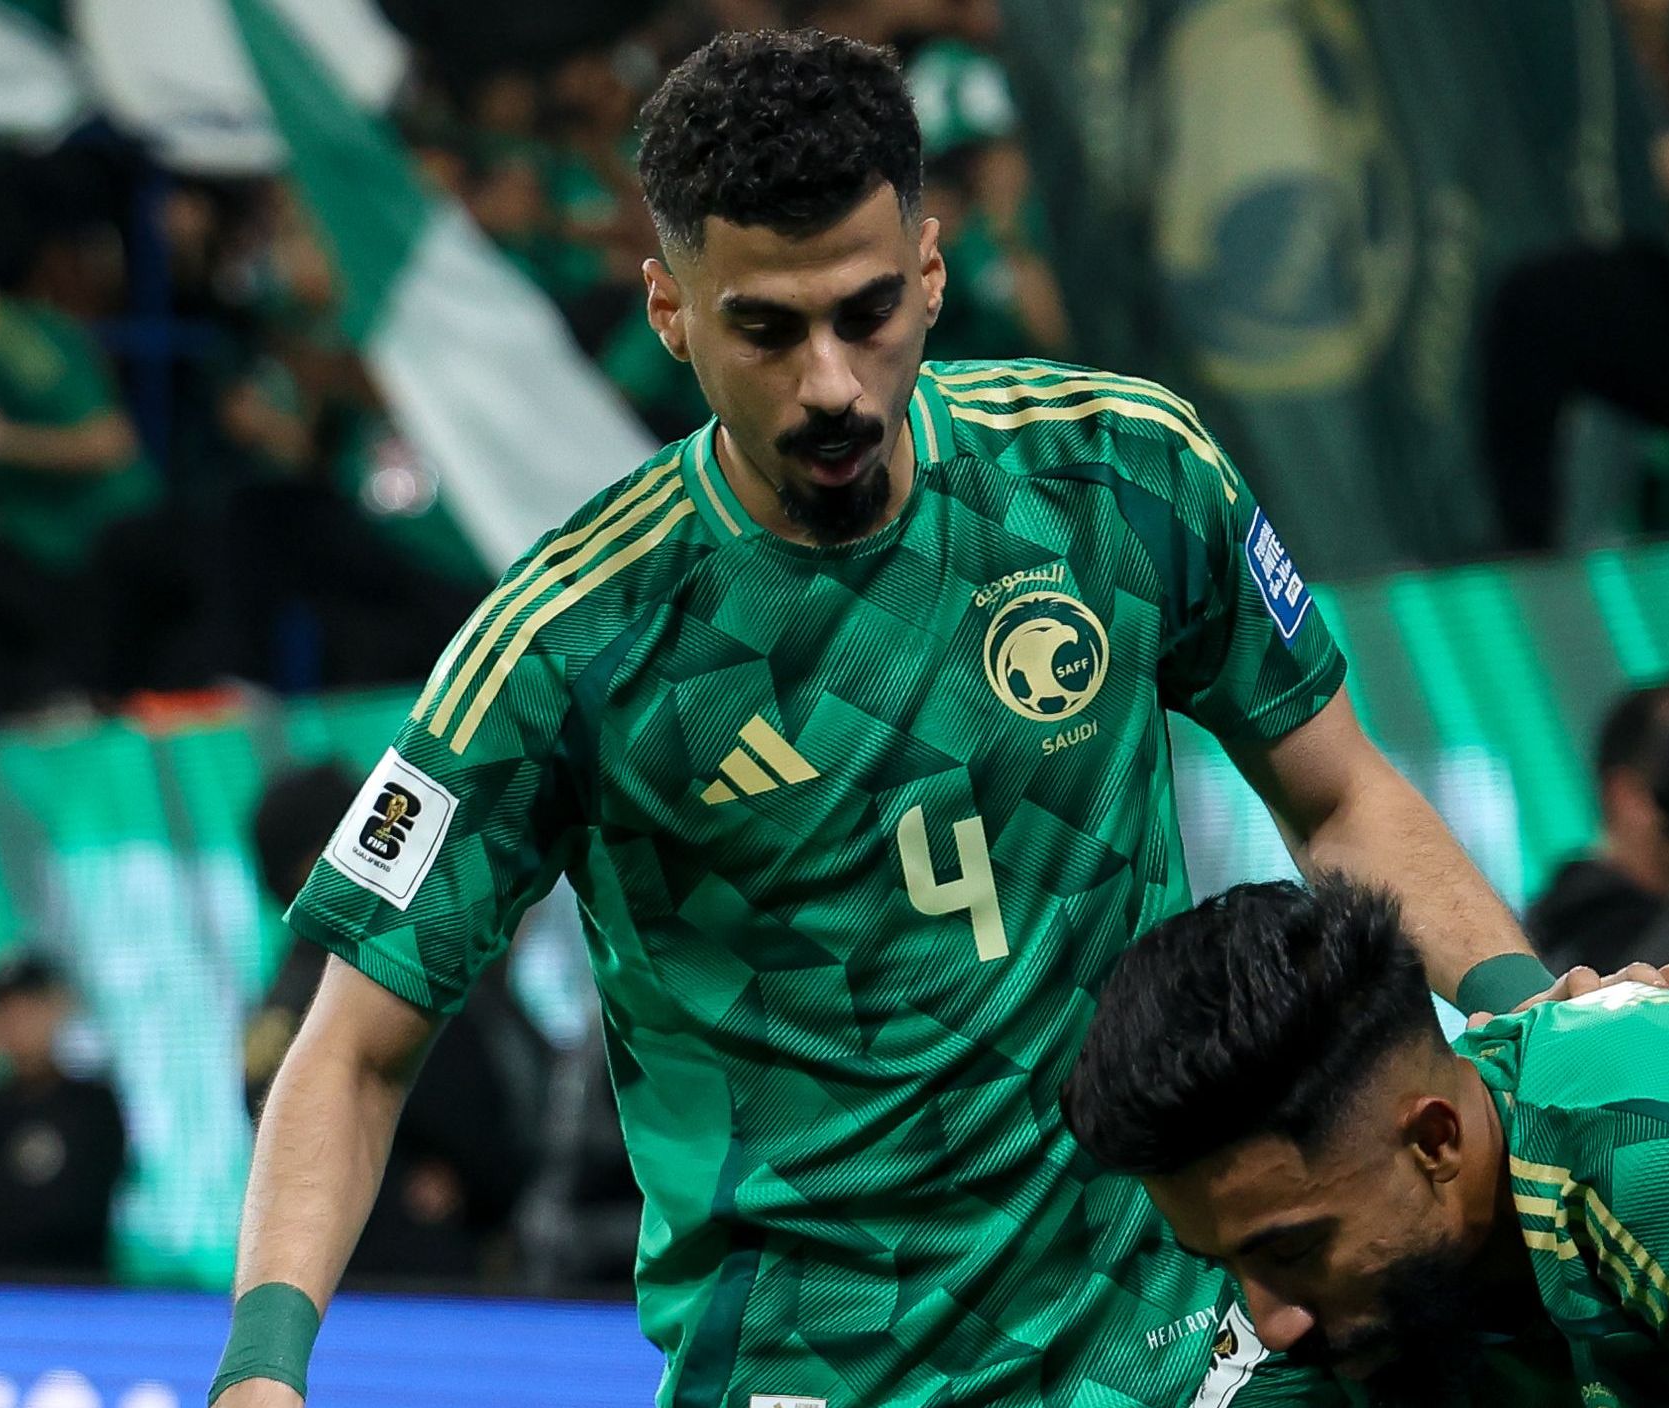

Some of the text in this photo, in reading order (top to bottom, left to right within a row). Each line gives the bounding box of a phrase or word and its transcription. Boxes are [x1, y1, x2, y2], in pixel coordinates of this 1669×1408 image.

[971, 564, 1065, 607] السعودية
[1056, 658, 1089, 678] SAFF
[1042, 720, 1098, 755] SAUDI
[366, 836, 388, 853] FIFA
[897, 805, 1010, 962] 4
[1146, 1305, 1219, 1350] HEAT.RDY
